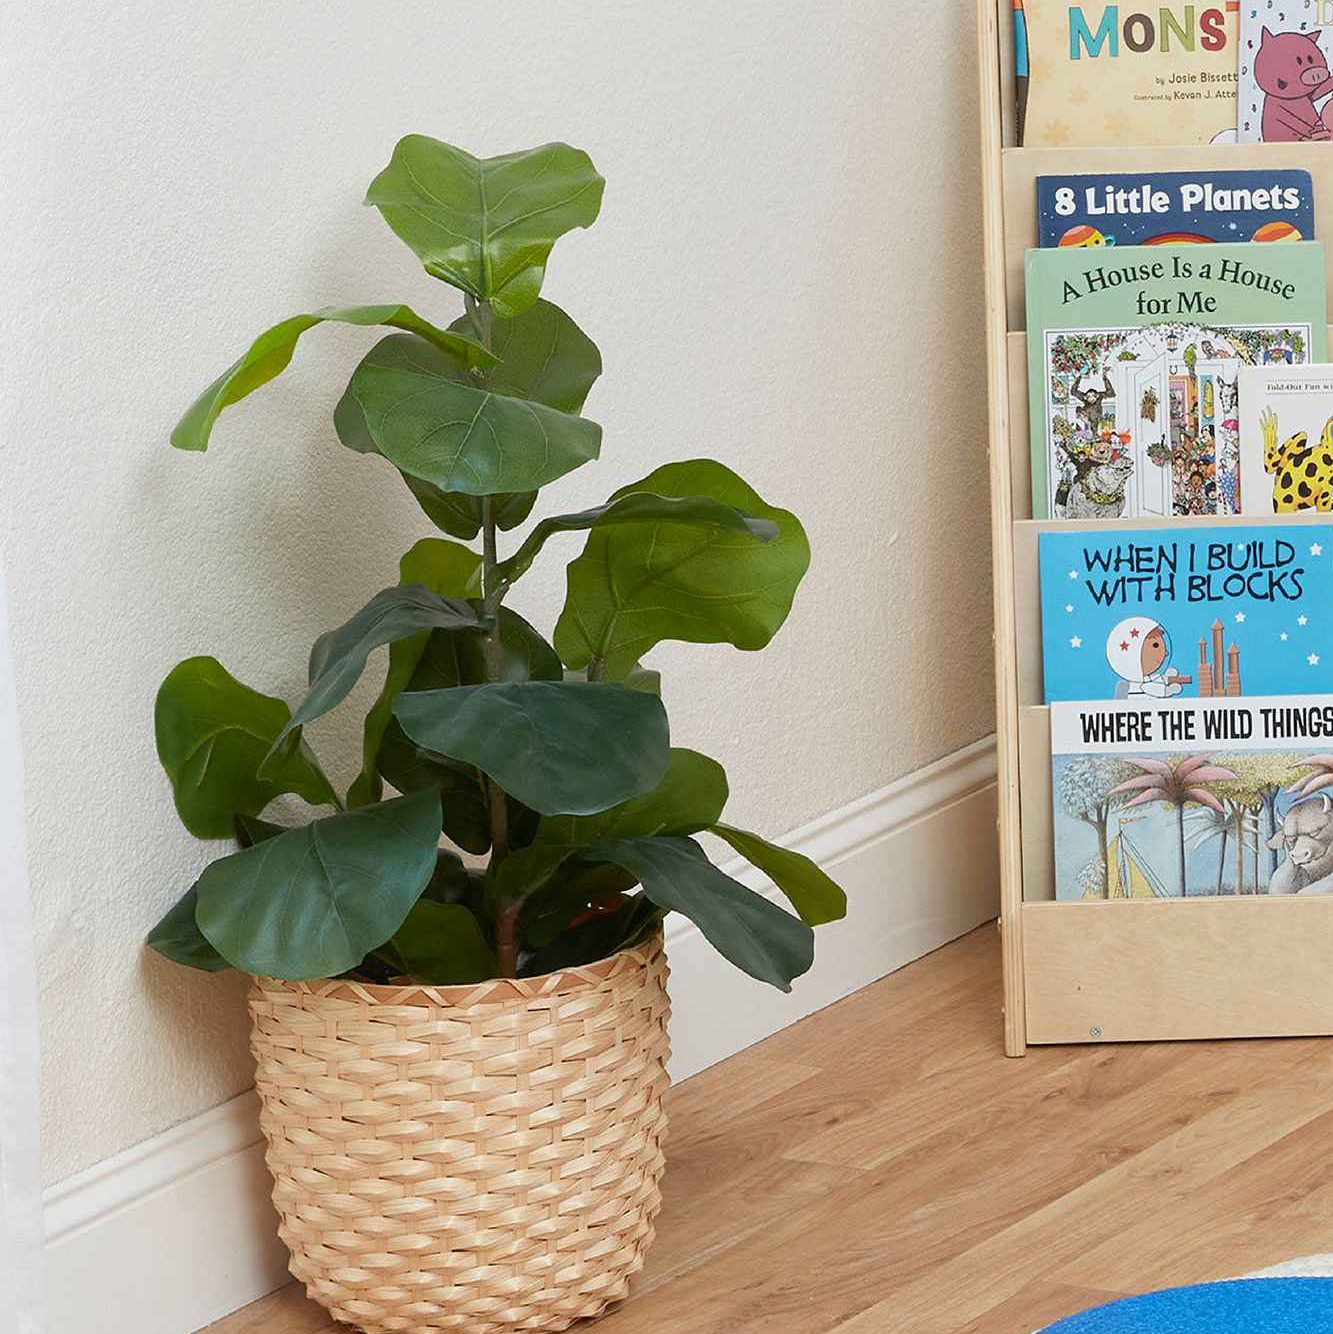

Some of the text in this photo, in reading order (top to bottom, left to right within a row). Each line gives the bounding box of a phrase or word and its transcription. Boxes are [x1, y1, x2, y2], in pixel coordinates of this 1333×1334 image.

[1156, 72, 1238, 86] by Josie Bissett
[1174, 91, 1201, 99] Kevan
[1204, 90, 1213, 99] J.
[1054, 182, 1300, 216] 8 Little Planets
[1061, 256, 1296, 305] A House Is a House
[1136, 291, 1218, 316] for Me
[1268, 383, 1301, 391] Fold-Out
[1083, 539, 1296, 573] WHEN I BUILD
[1085, 567, 1305, 607] WITH BLOCKS
[1080, 712, 1152, 743] WHERE
[1158, 709, 1196, 741] THE
[1202, 709, 1253, 741] WILD
